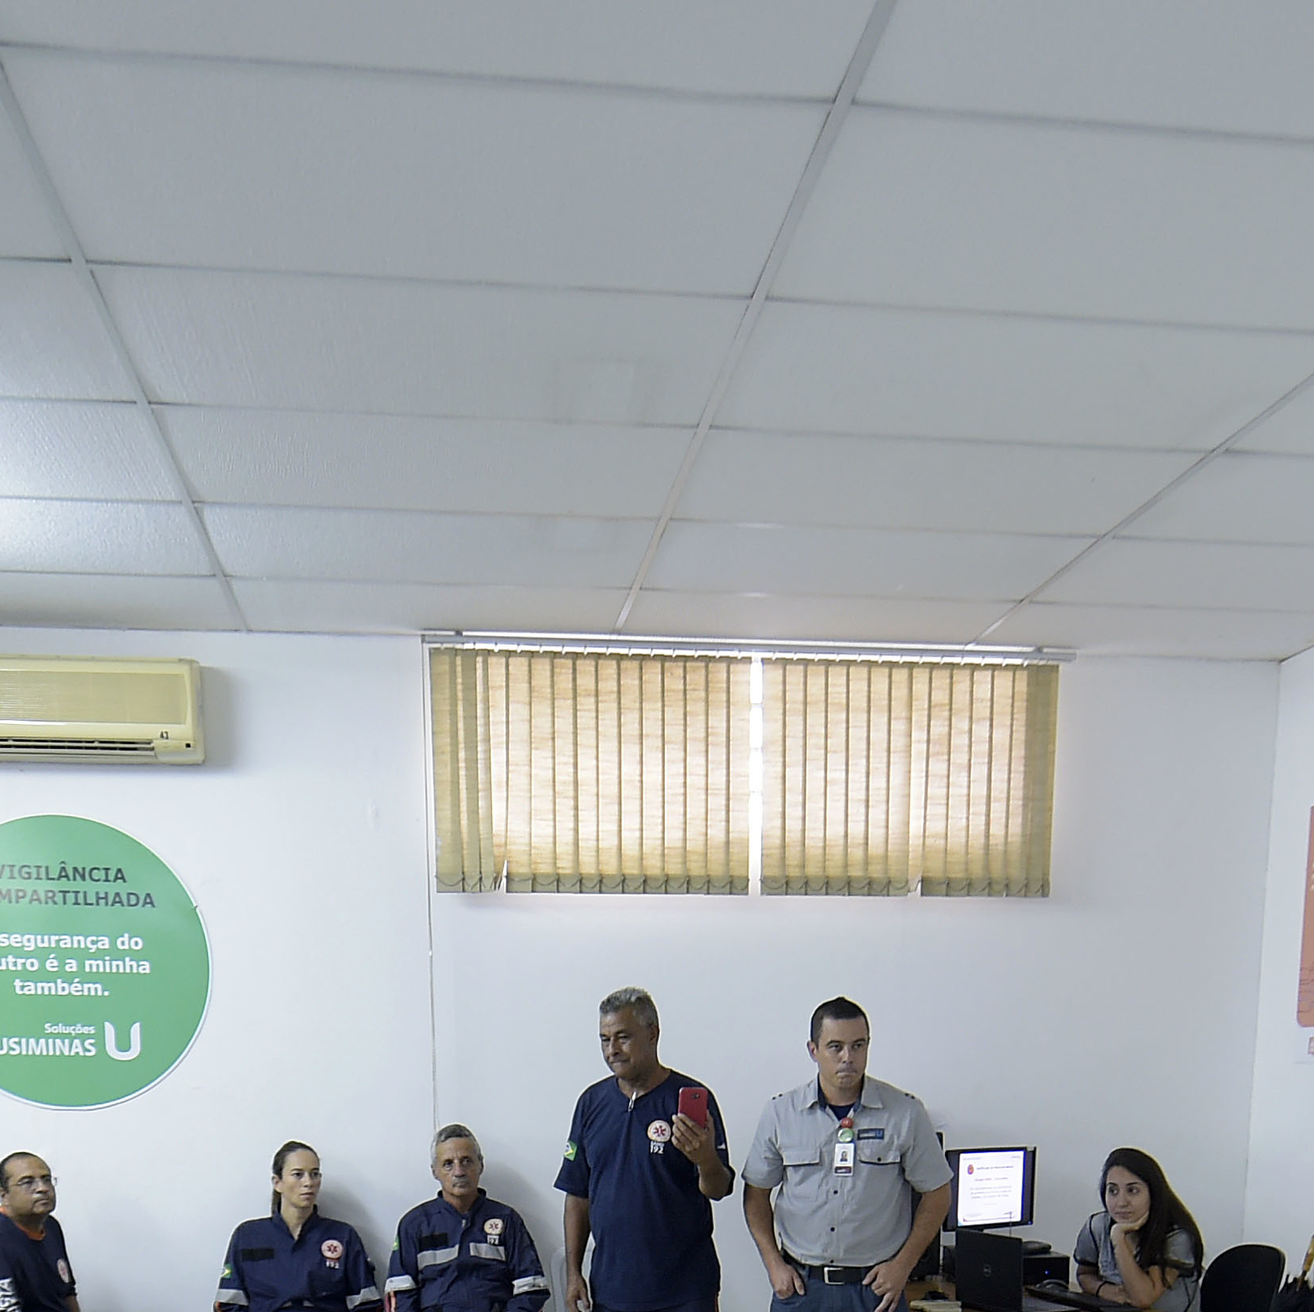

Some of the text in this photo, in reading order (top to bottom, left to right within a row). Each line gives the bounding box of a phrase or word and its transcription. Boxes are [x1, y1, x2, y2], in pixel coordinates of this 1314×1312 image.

[116, 933, 143, 950] do
[45, 954, 59, 972] é
[65, 958, 77, 972] a
[85, 956, 151, 974] minha
[14, 978, 110, 996] também.
[44, 1022, 96, 1036] Soluções
[104, 1021, 141, 1061] U
